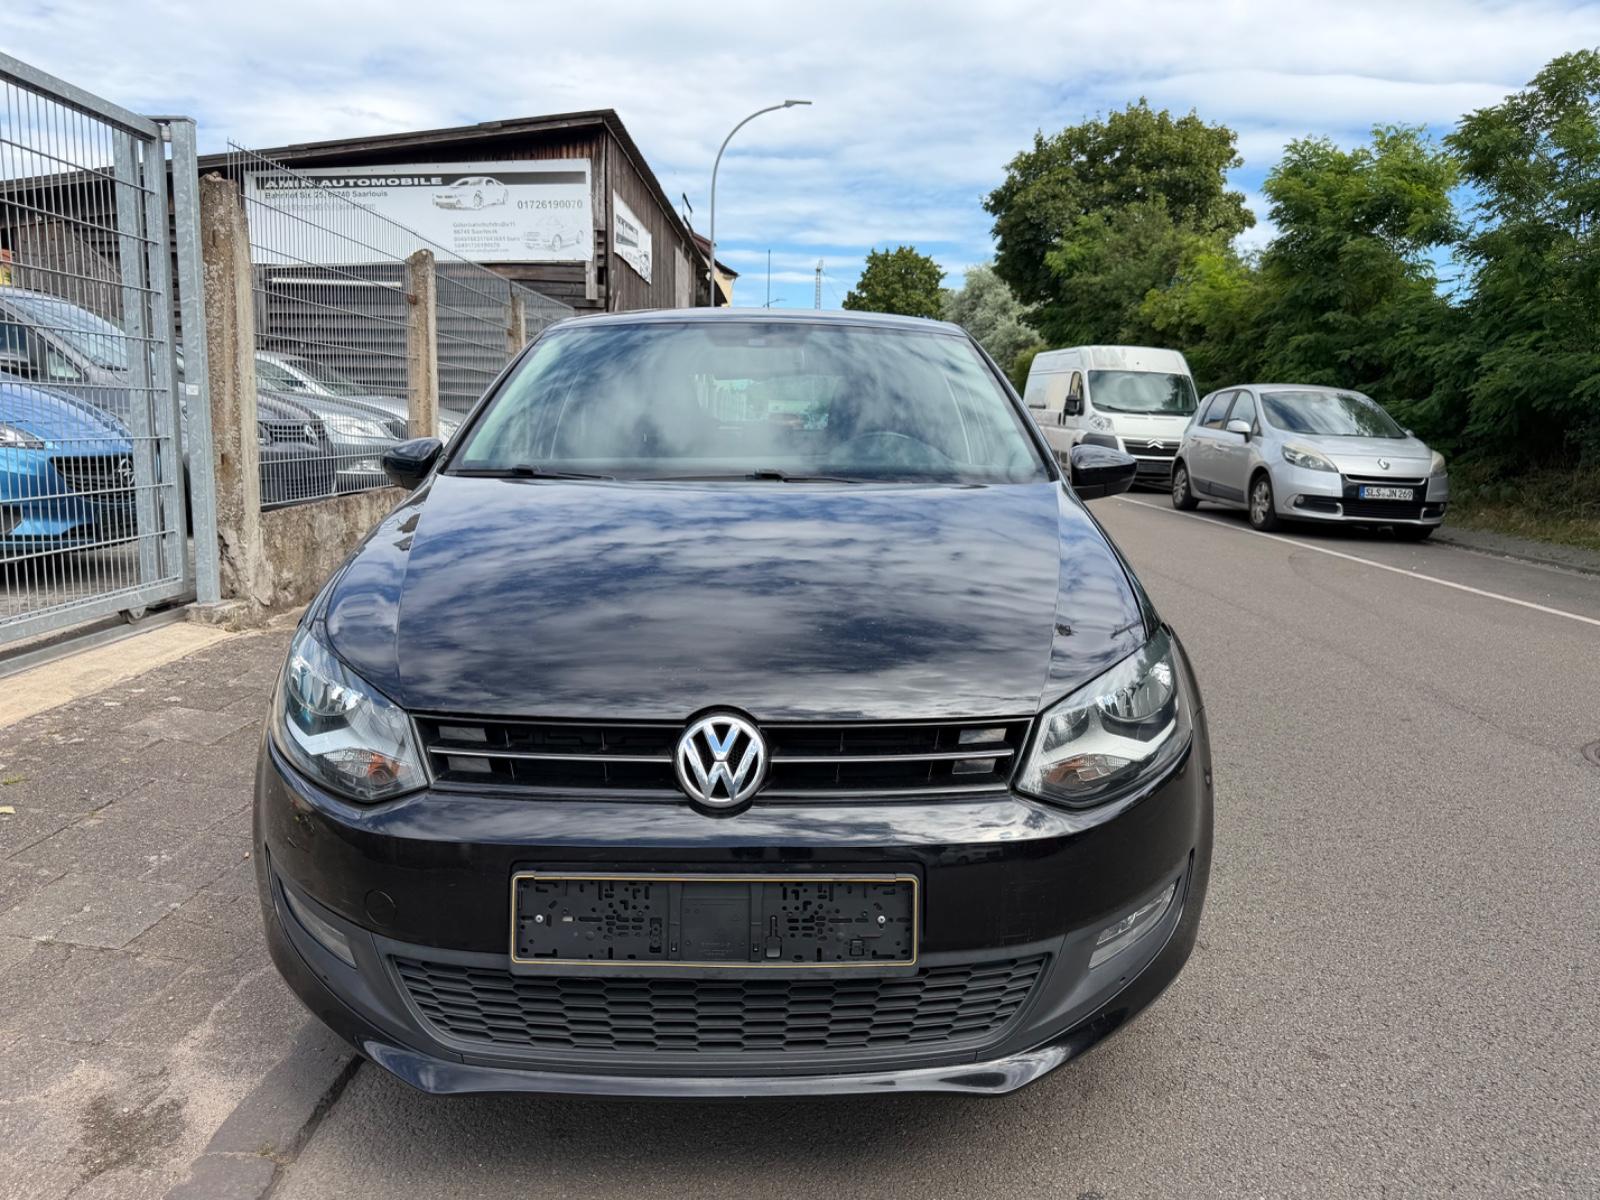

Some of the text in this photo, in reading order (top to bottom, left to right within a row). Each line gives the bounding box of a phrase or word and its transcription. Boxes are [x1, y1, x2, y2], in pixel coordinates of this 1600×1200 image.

[319, 177, 443, 188] AUTOMOBILE
[352, 189, 388, 198] Saarlouis
[517, 200, 583, 209] 01726190070
